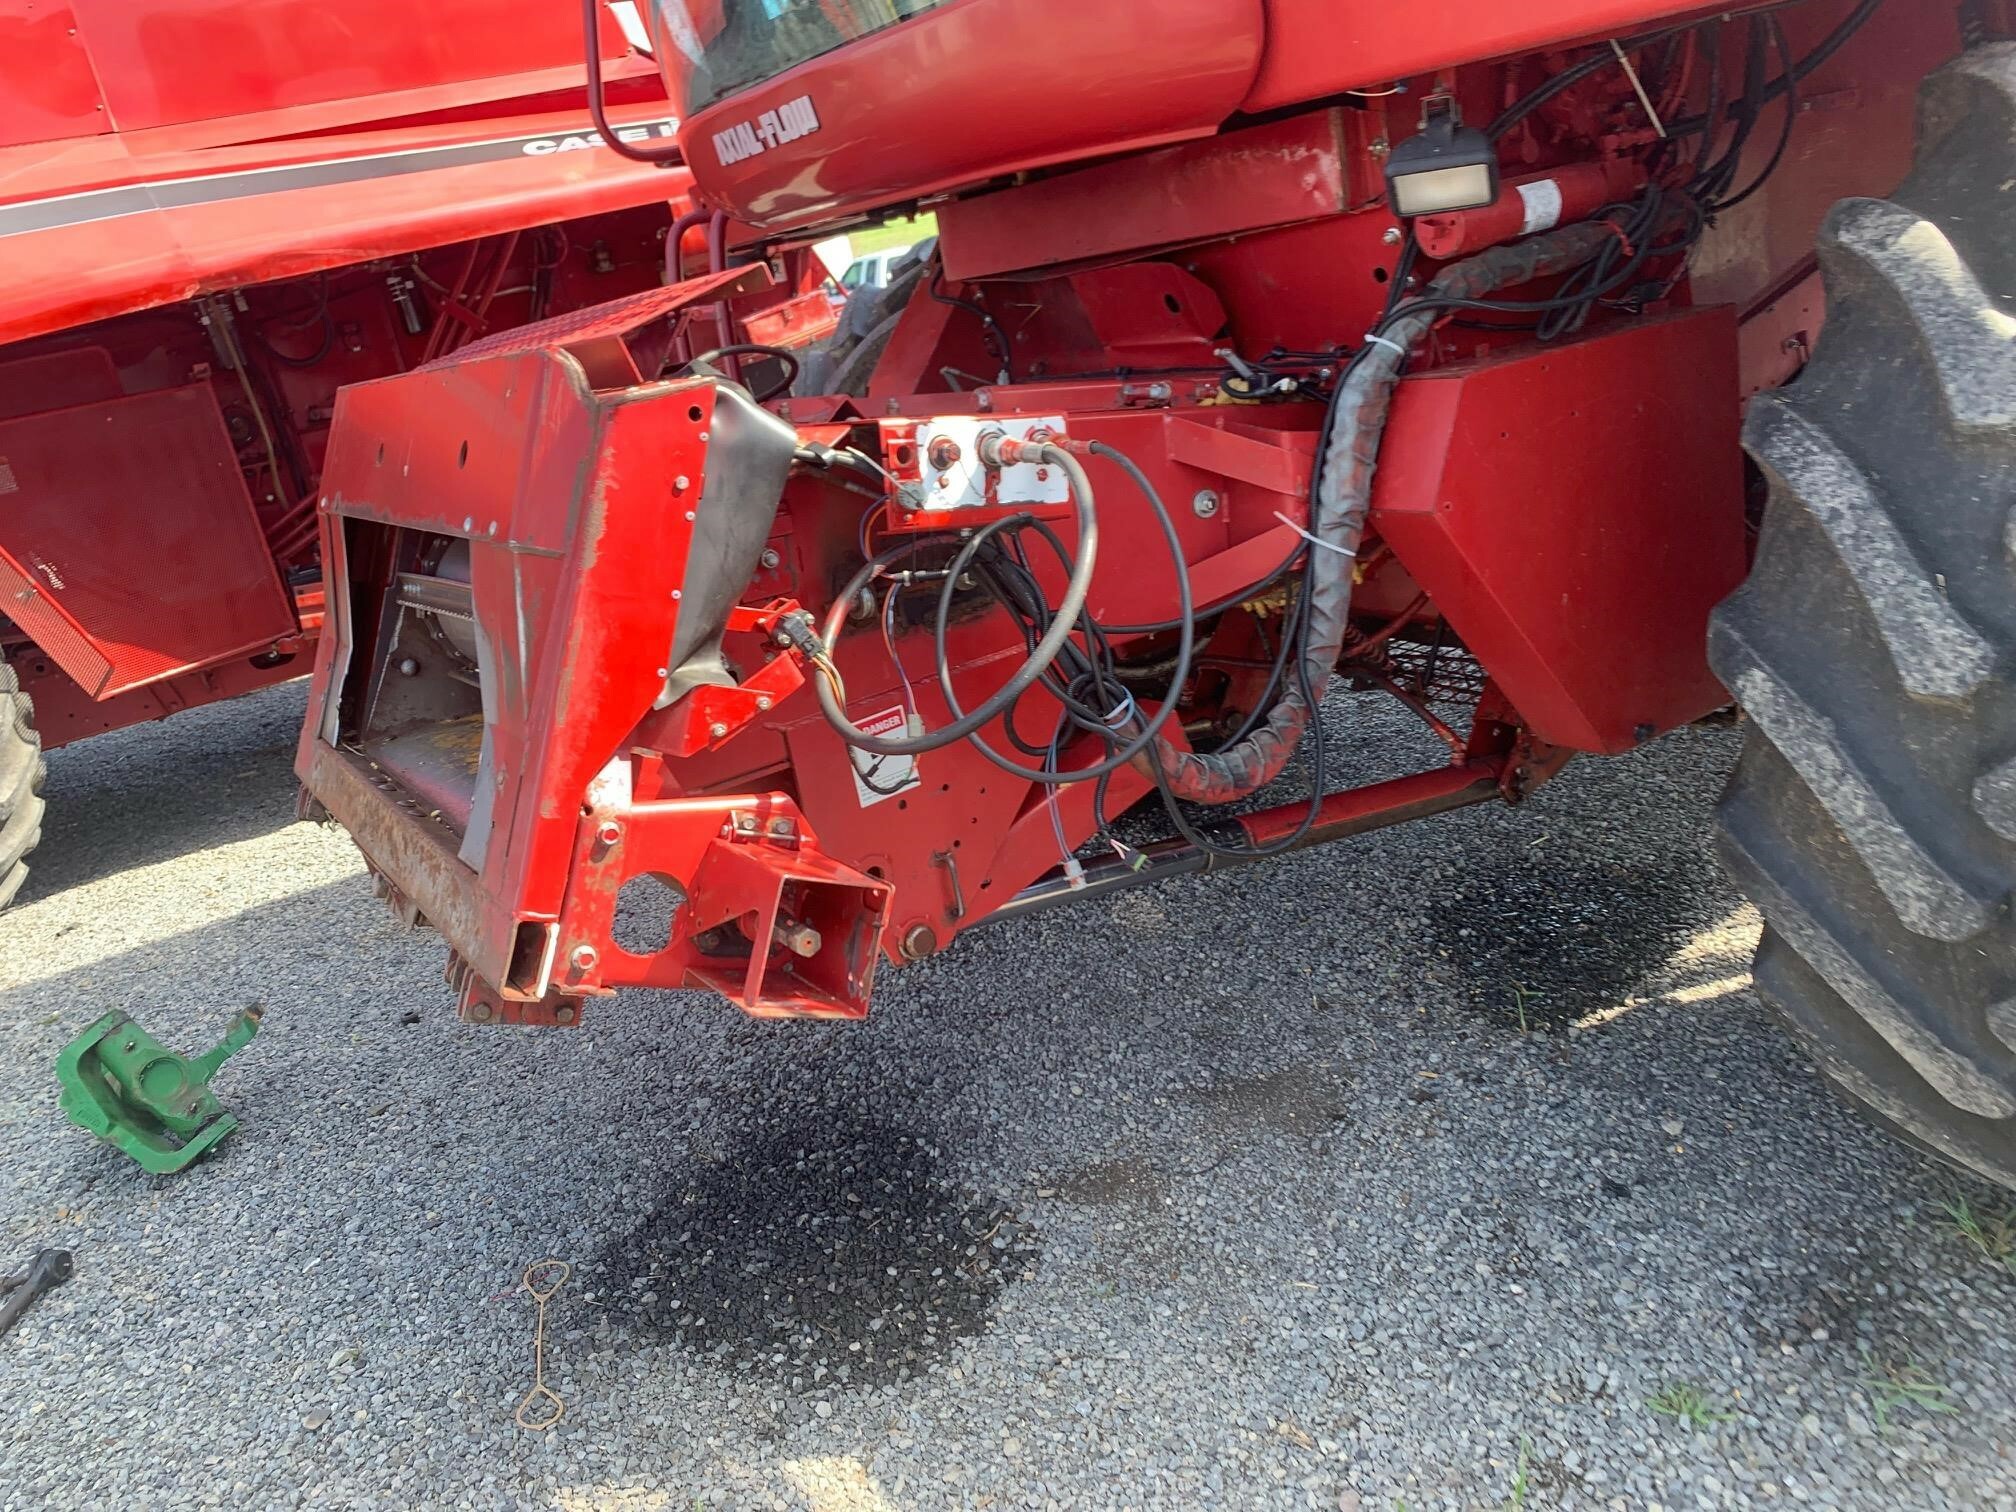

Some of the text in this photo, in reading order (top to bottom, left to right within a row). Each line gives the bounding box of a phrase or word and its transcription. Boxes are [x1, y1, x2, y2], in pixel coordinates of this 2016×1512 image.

[522, 127, 650, 156] CASE
[712, 95, 820, 167] AXIAL-FLOW
[862, 715, 902, 735] DANGER
